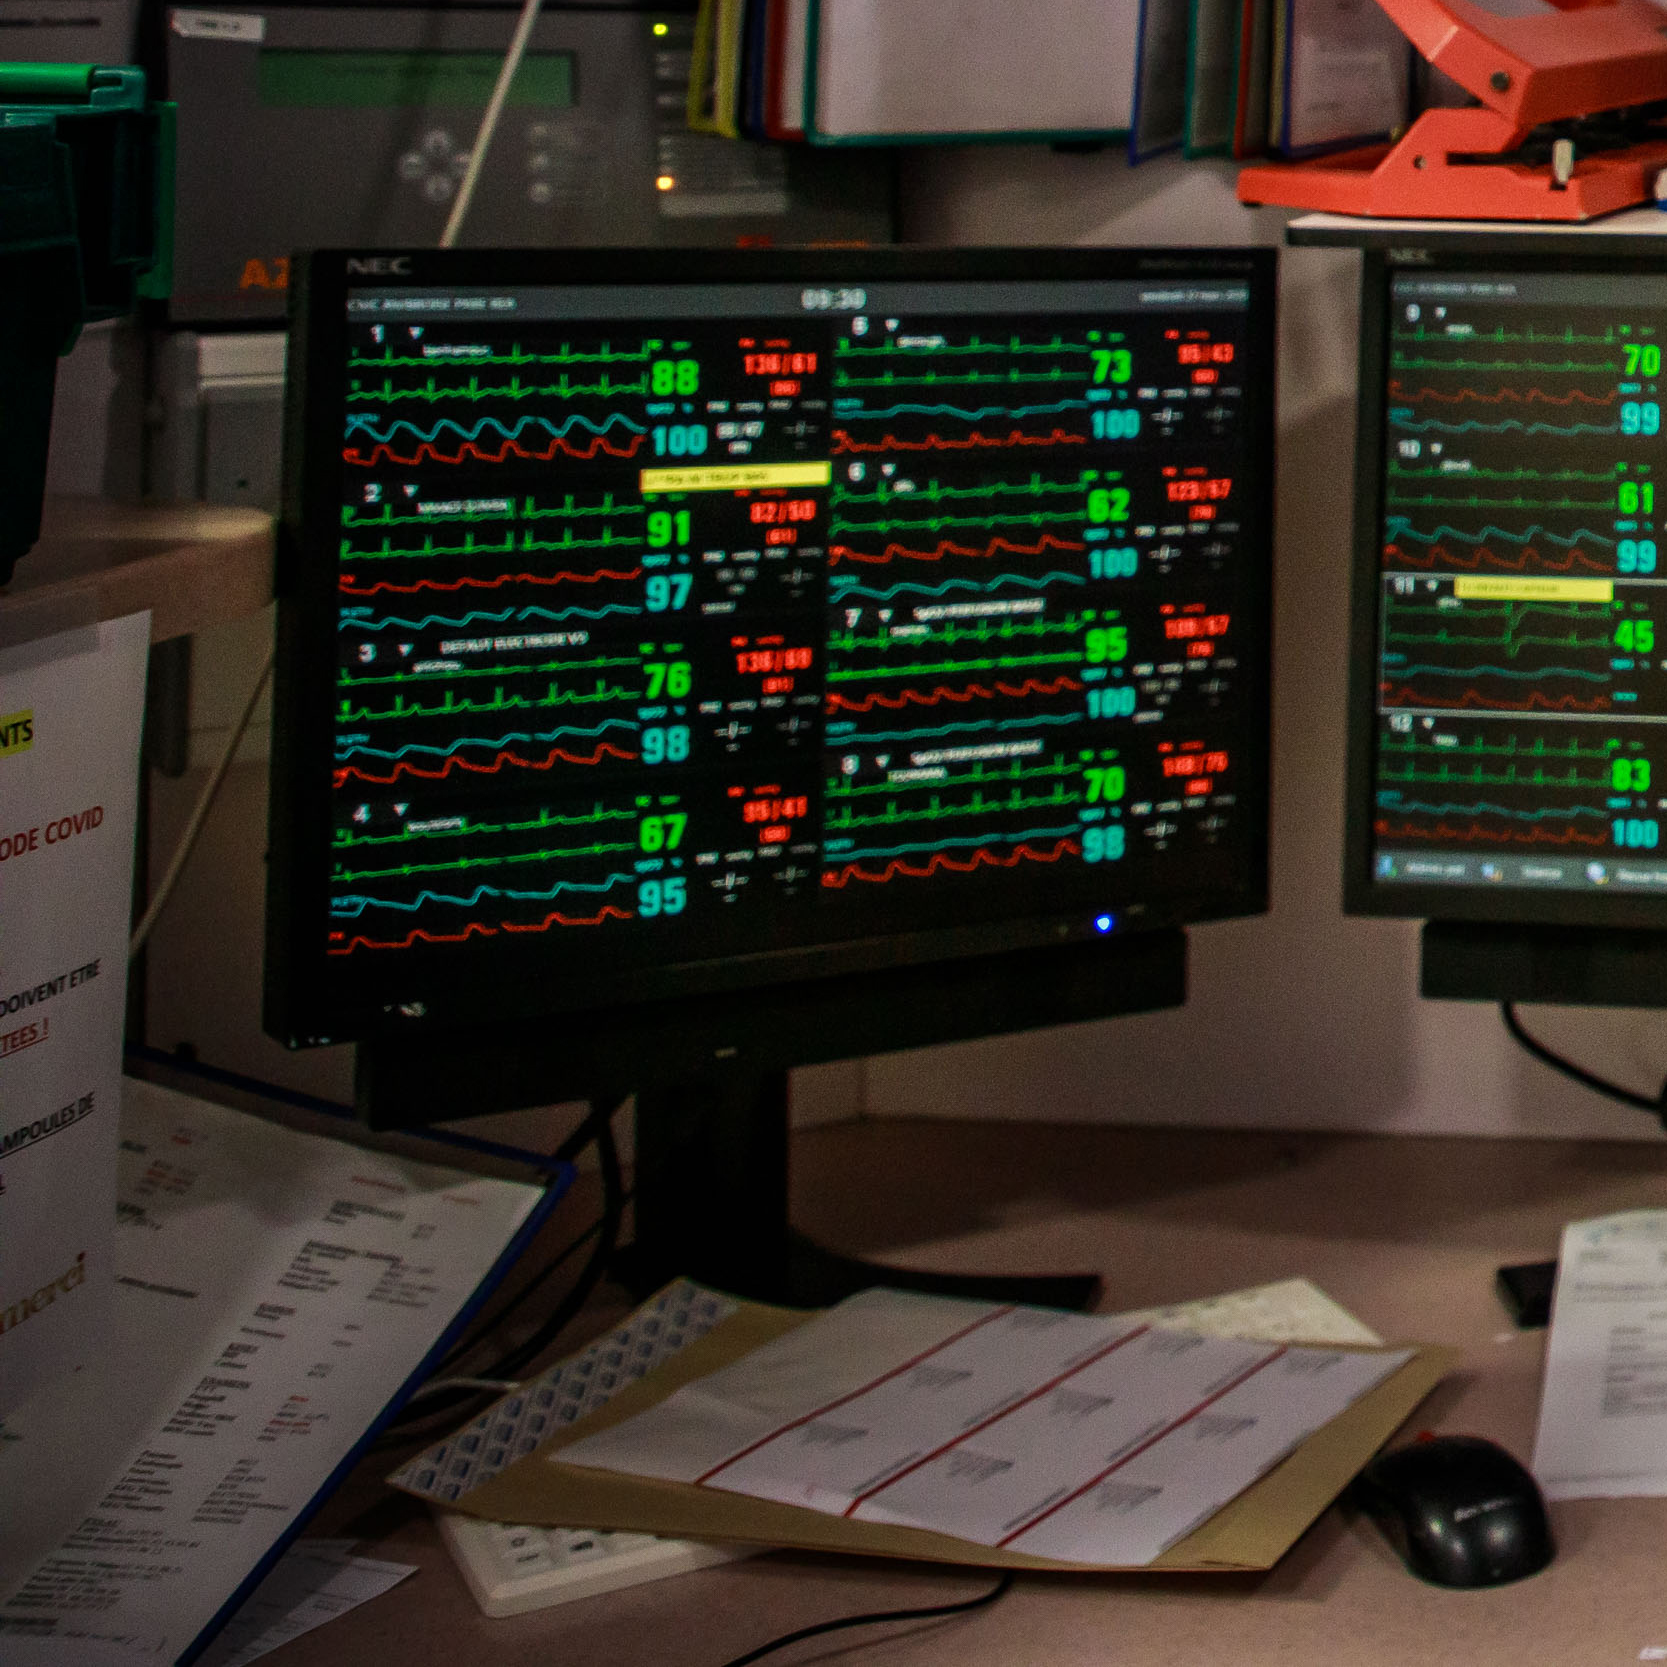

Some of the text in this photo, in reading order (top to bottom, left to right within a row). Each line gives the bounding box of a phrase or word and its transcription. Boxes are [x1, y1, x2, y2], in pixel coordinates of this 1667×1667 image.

[346, 257, 412, 275] NEC
[1090, 349, 1133, 384] 73
[1622, 343, 1660, 376] 70
[652, 359, 700, 396] 88
[1090, 408, 1140, 440] 100
[1620, 401, 1660, 435] 99
[652, 424, 708, 455] 100
[1088, 487, 1130, 523] 62
[1618, 481, 1655, 514] 61
[647, 510, 692, 547] 91
[1088, 546, 1139, 580] 100
[1616, 539, 1657, 574] 99
[646, 572, 694, 612] 97
[1614, 618, 1655, 652] 45
[358, 643, 377, 663] 3
[642, 661, 692, 699] 76
[1087, 685, 1137, 720] 100
[641, 724, 690, 765] 98
[1083, 767, 1126, 802] 70
[1611, 758, 1651, 792] 83
[44, 805, 104, 845] COVID
[352, 803, 371, 824] 4
[639, 812, 688, 852] 67
[1612, 818, 1659, 849] 100
[638, 875, 687, 918] 95
[78, 1092, 95, 1114] DE
